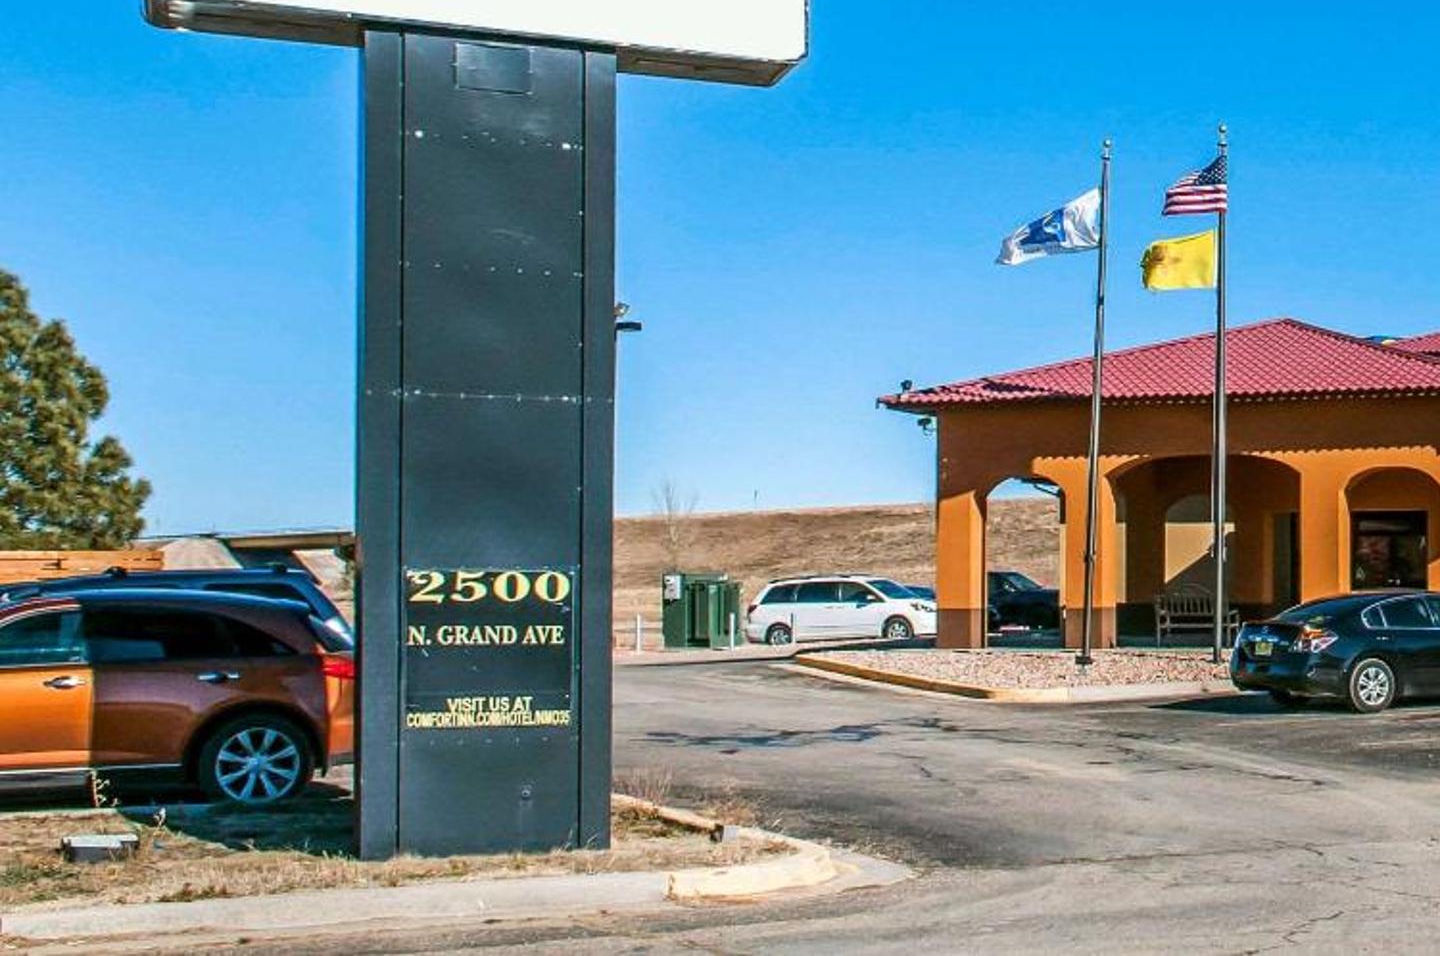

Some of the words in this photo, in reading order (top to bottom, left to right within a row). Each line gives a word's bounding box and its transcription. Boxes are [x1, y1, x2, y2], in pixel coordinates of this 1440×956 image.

[406, 570, 570, 603] 2500
[407, 625, 431, 645] N.
[436, 625, 517, 645] GRAND
[522, 625, 564, 644] AVE
[447, 698, 486, 712] VISIT
[489, 697, 510, 711] US
[513, 696, 533, 711] AT
